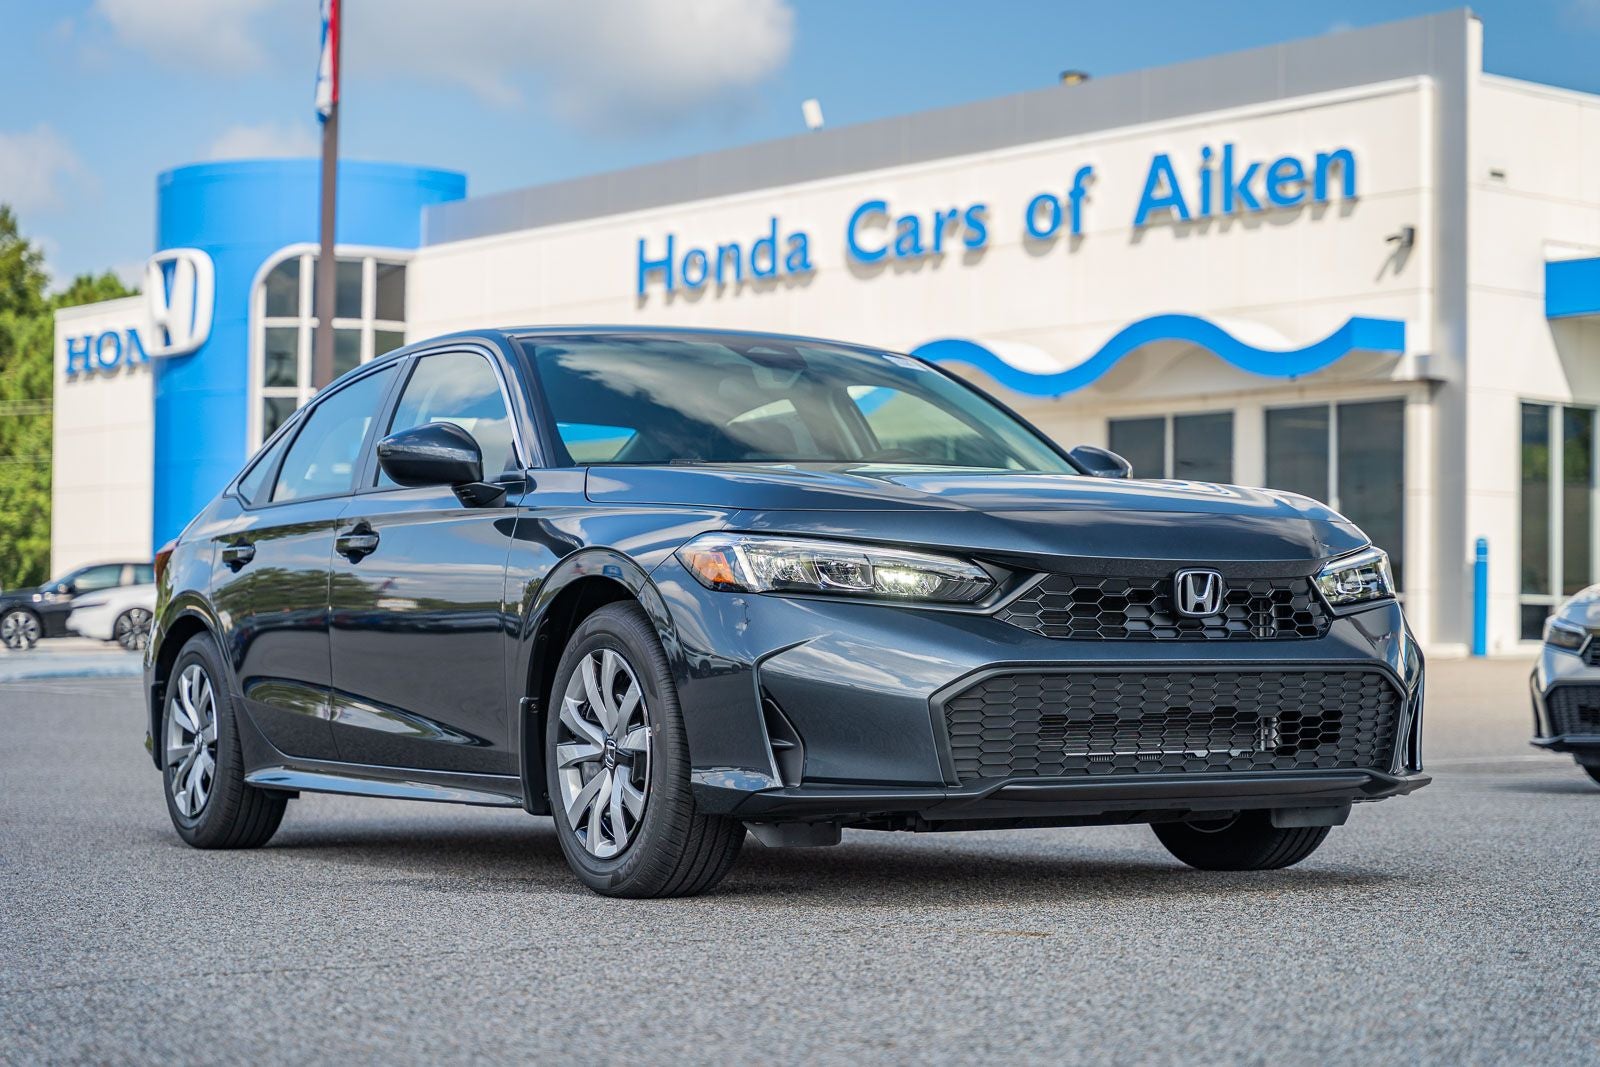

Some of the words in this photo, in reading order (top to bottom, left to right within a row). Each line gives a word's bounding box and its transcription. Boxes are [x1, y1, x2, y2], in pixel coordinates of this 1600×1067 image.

[637, 217, 812, 297] Honda
[846, 199, 988, 264] Cars
[1025, 165, 1094, 240] of
[1133, 143, 1357, 227] Aiken
